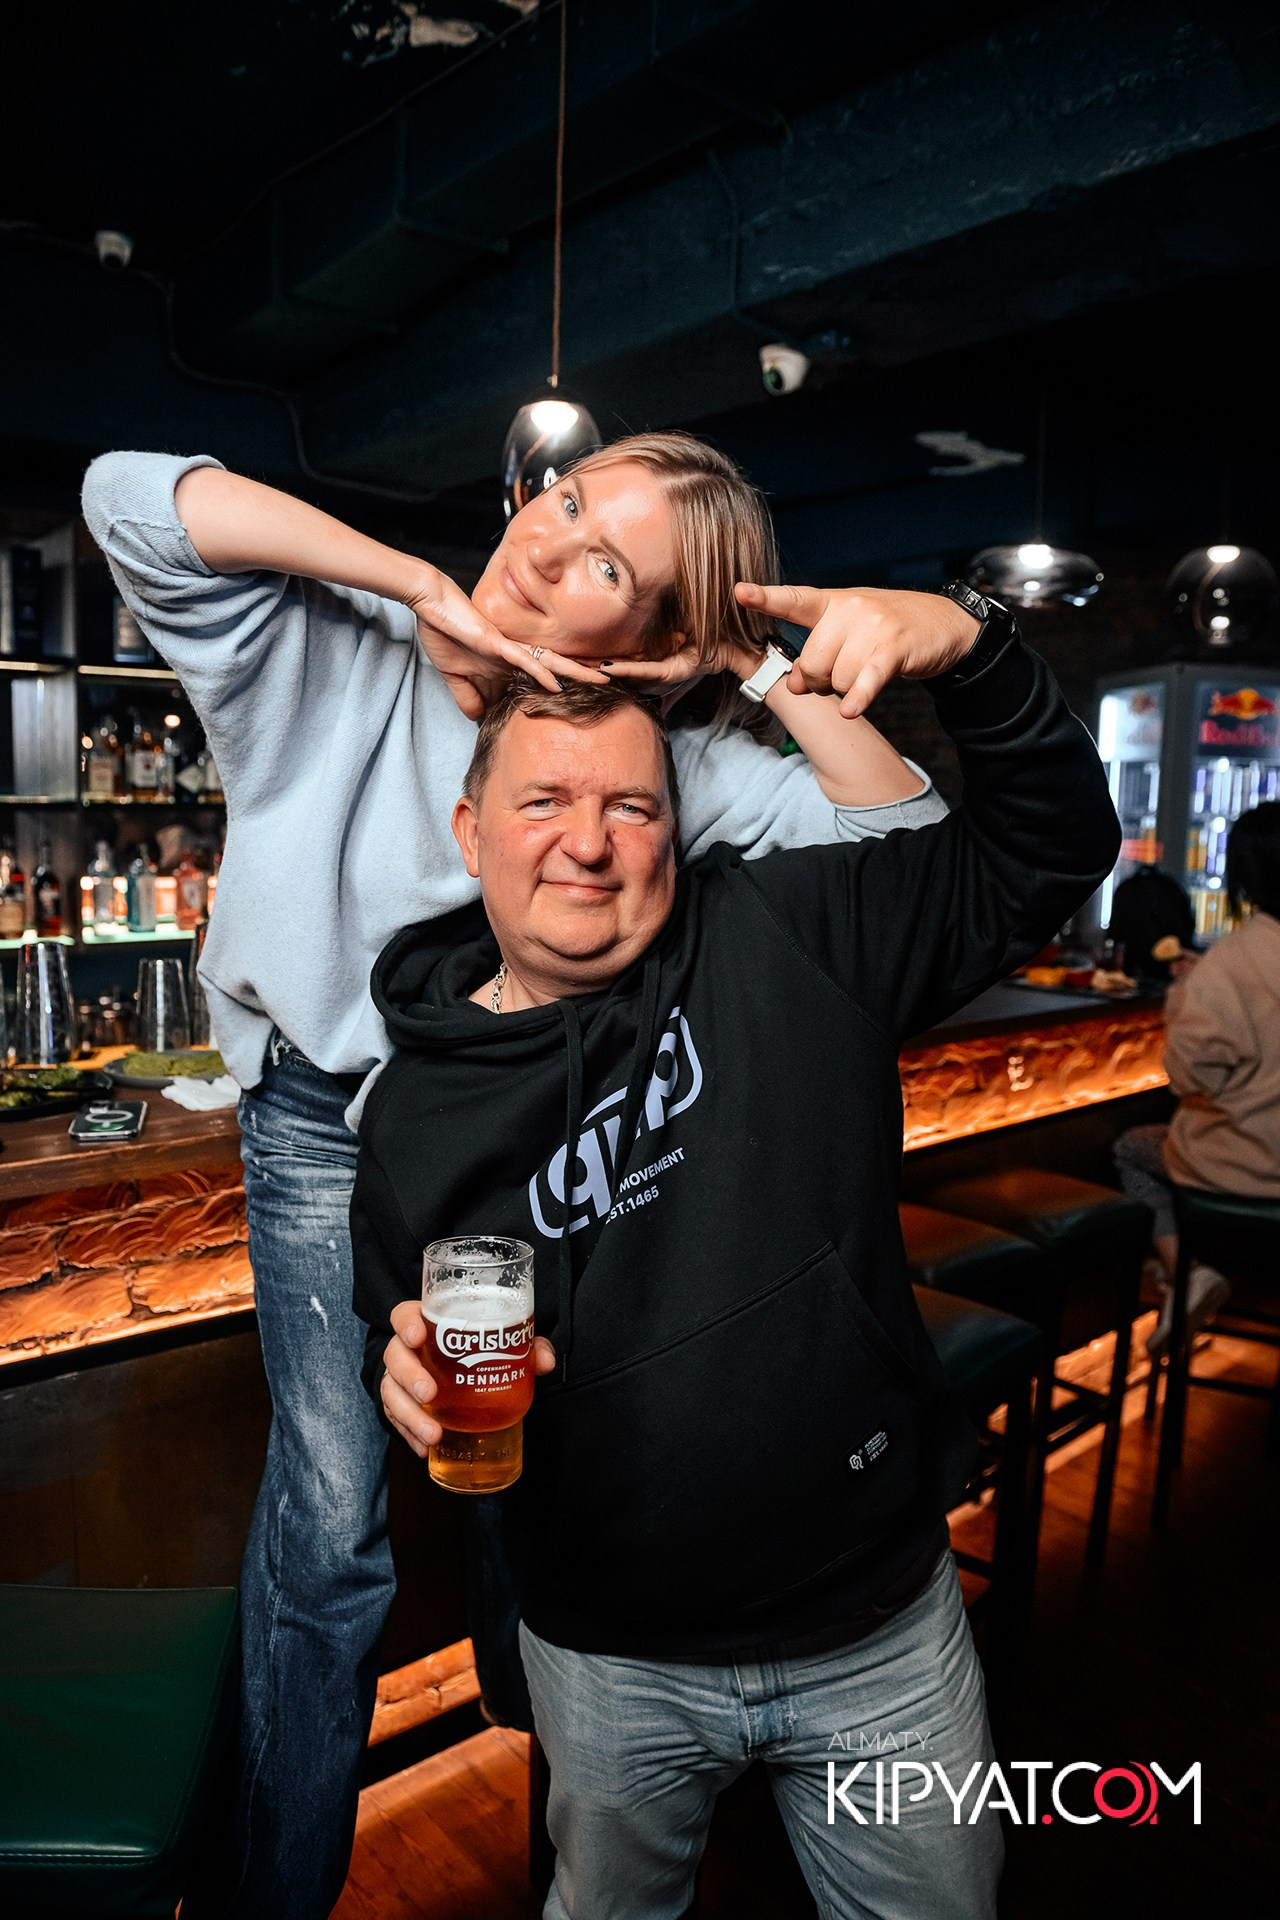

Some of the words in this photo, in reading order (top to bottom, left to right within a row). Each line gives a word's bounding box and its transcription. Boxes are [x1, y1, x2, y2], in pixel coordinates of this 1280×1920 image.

[619, 1146, 686, 1194] MOVEMENT
[435, 1317, 535, 1359] Carlsberg
[455, 1367, 526, 1386] DENMARK
[476, 1364, 512, 1373] COPENHAGEN
[487, 1384, 513, 1393] ONWARDS
